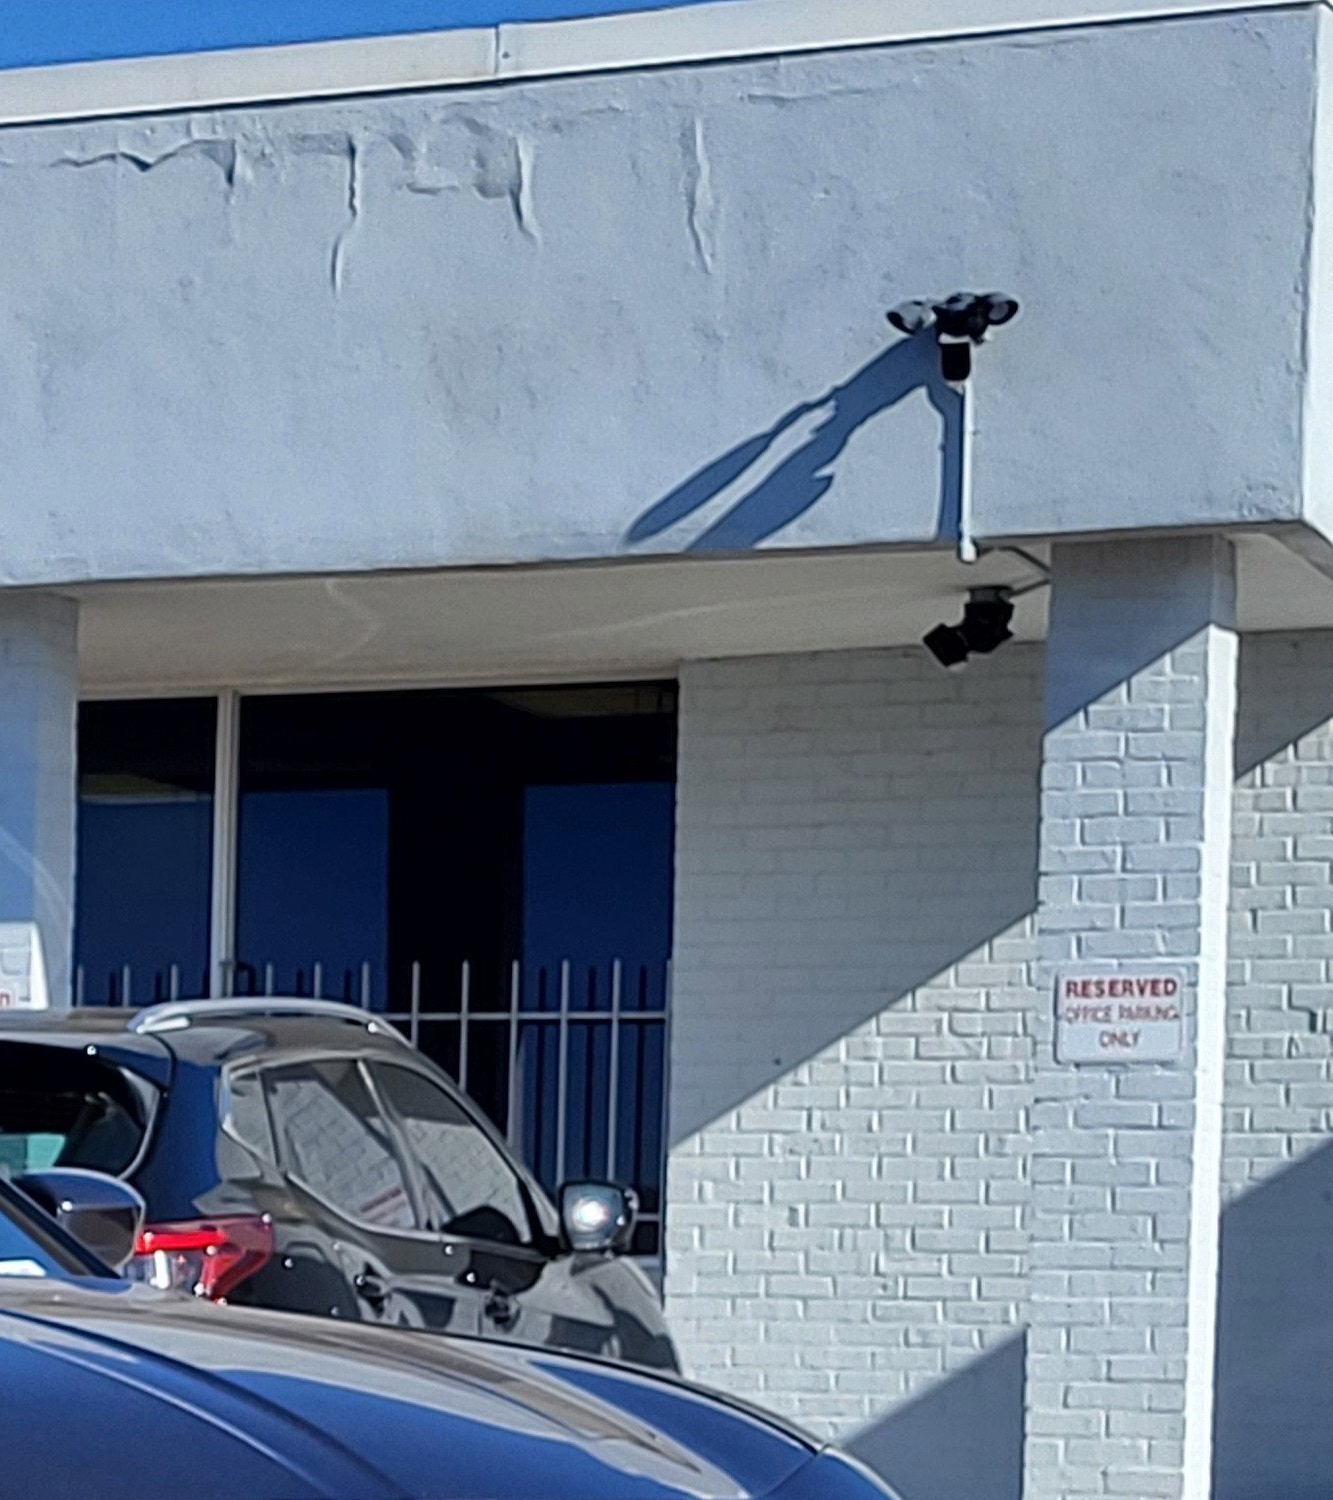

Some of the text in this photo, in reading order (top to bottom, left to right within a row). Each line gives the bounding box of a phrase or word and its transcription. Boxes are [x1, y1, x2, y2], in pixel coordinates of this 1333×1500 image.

[1065, 978, 1178, 999] RESERVED
[1065, 1003, 1180, 1023] OFFICE PARKING
[1099, 1029, 1141, 1048] ONLY
